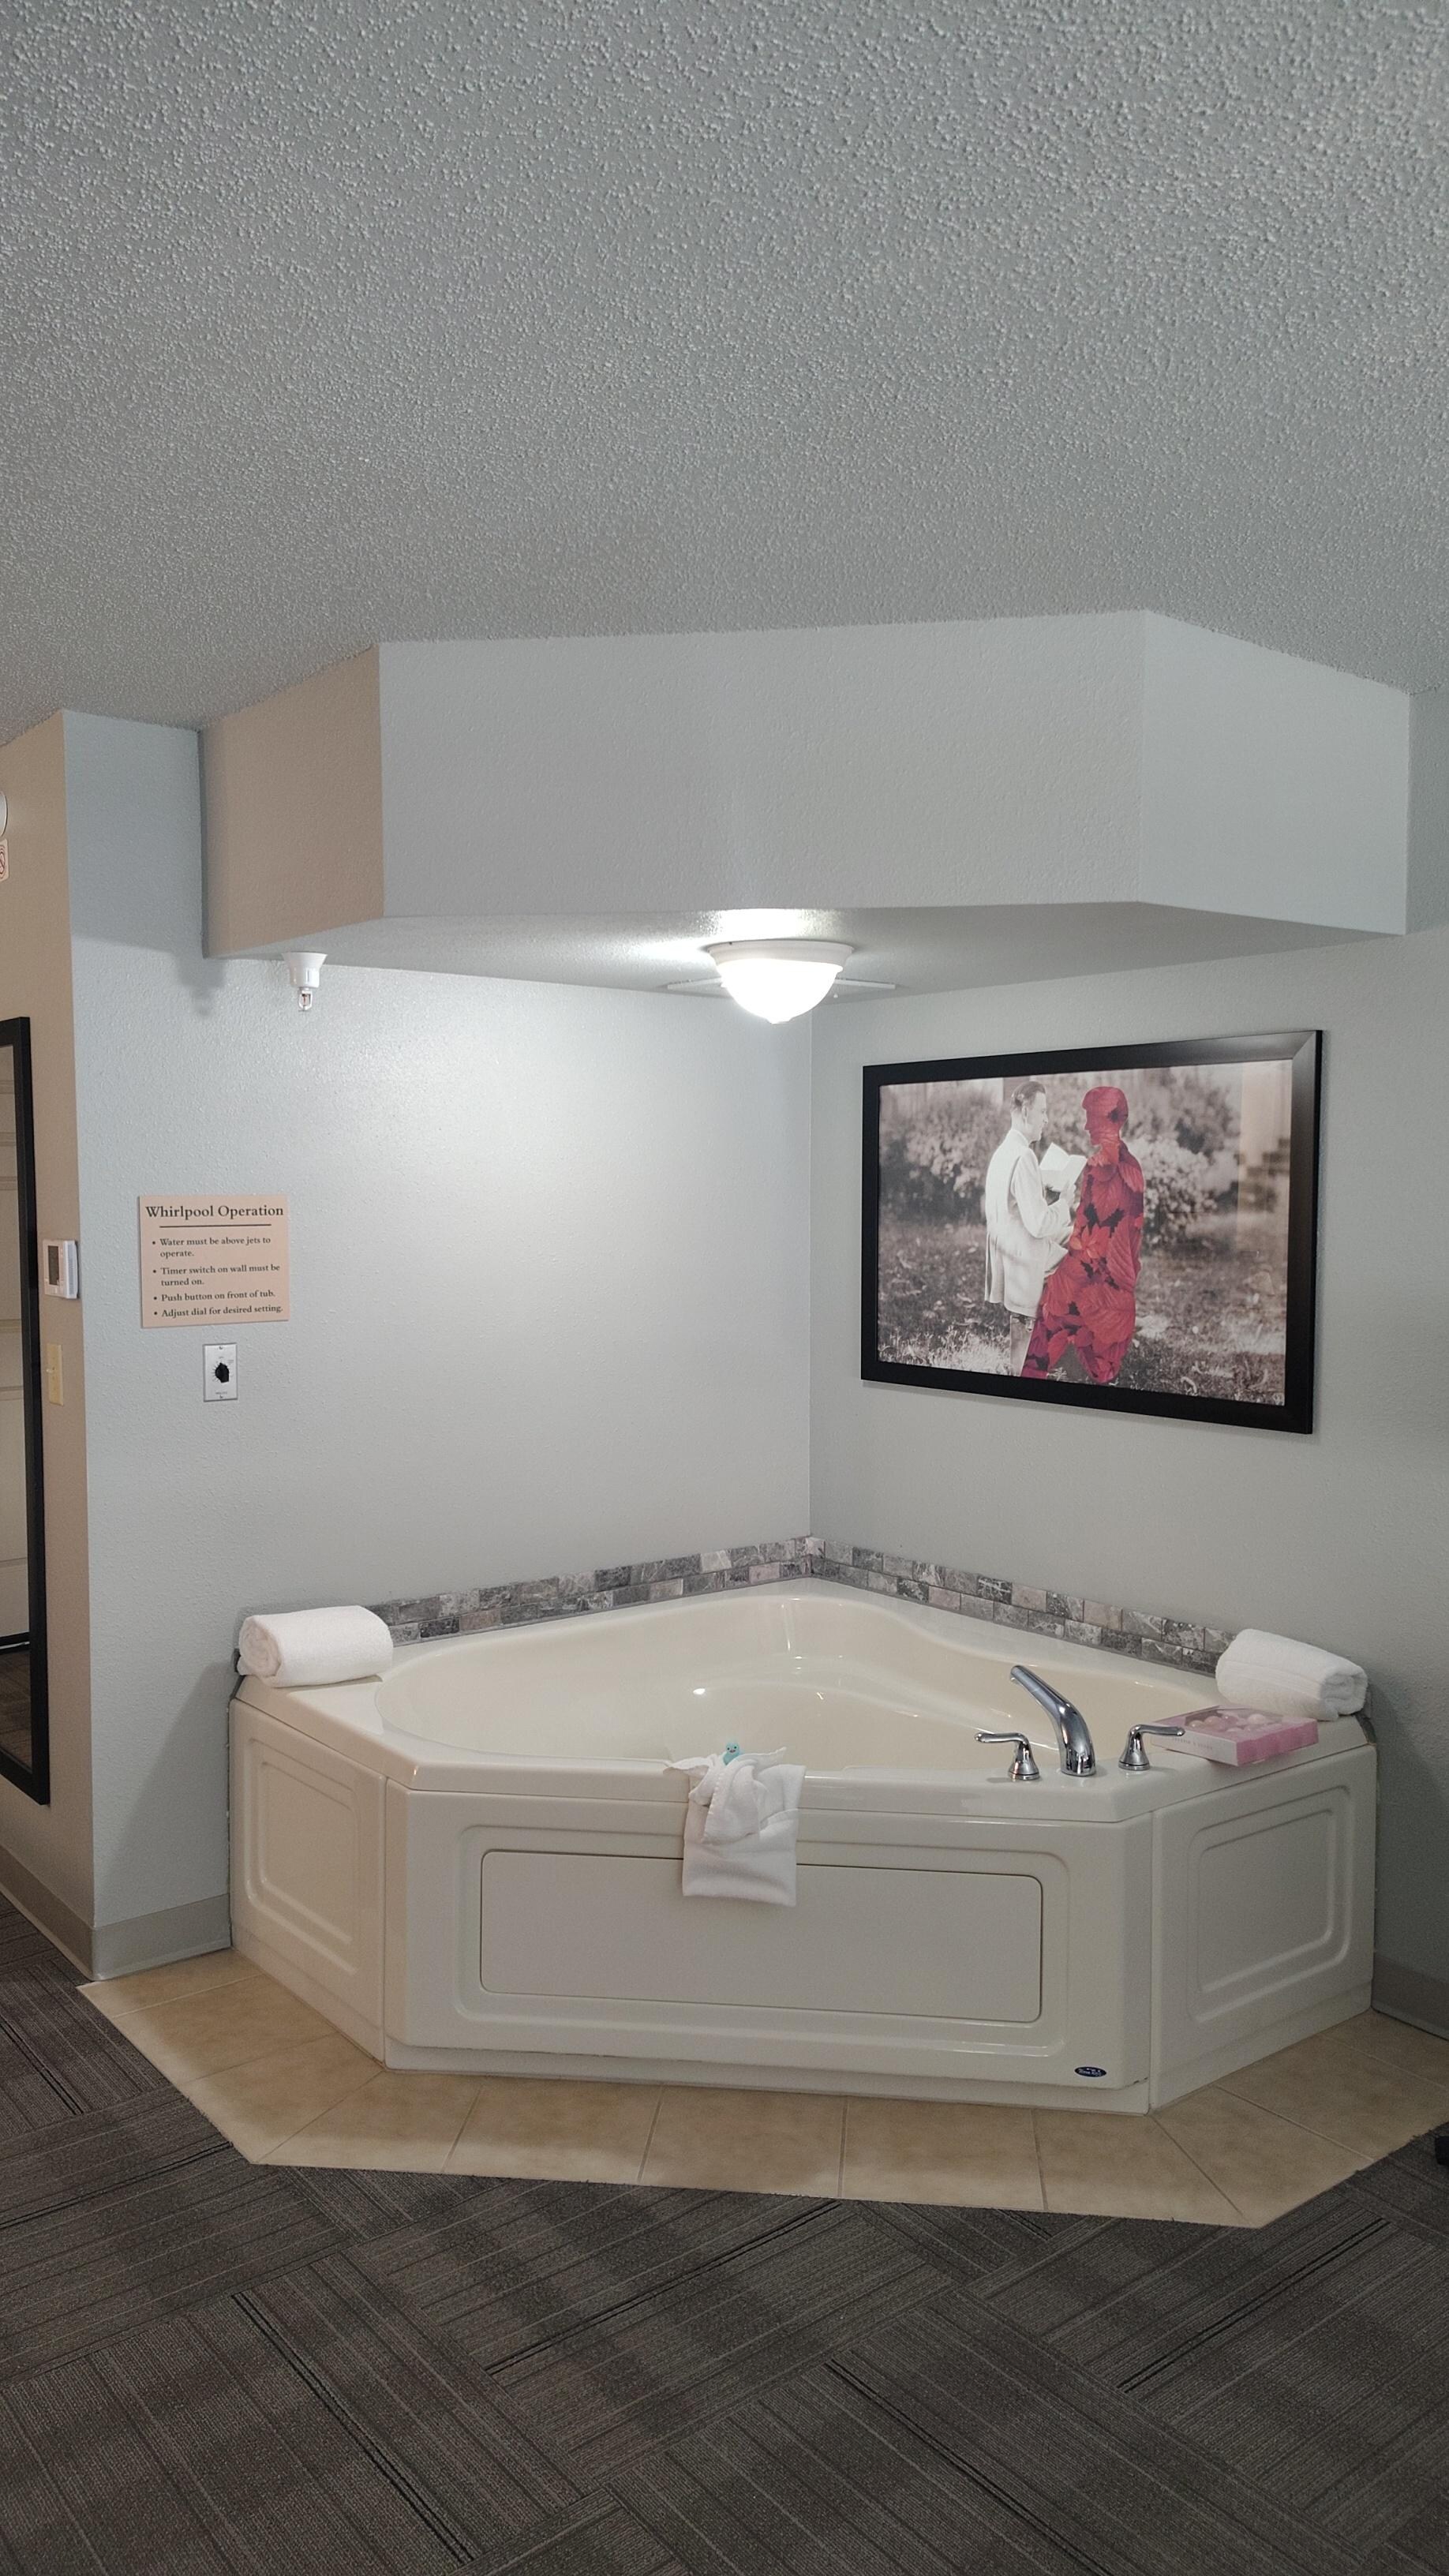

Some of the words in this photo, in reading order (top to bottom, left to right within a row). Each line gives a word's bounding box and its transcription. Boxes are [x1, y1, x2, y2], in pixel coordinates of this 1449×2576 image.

[145, 1205, 213, 1220] Whirlpool
[218, 1205, 283, 1219] Operation
[246, 1237, 260, 1245] jets
[160, 1250, 194, 1259] operate.
[185, 1292, 212, 1301] button
[162, 1309, 189, 1318] Adjust
